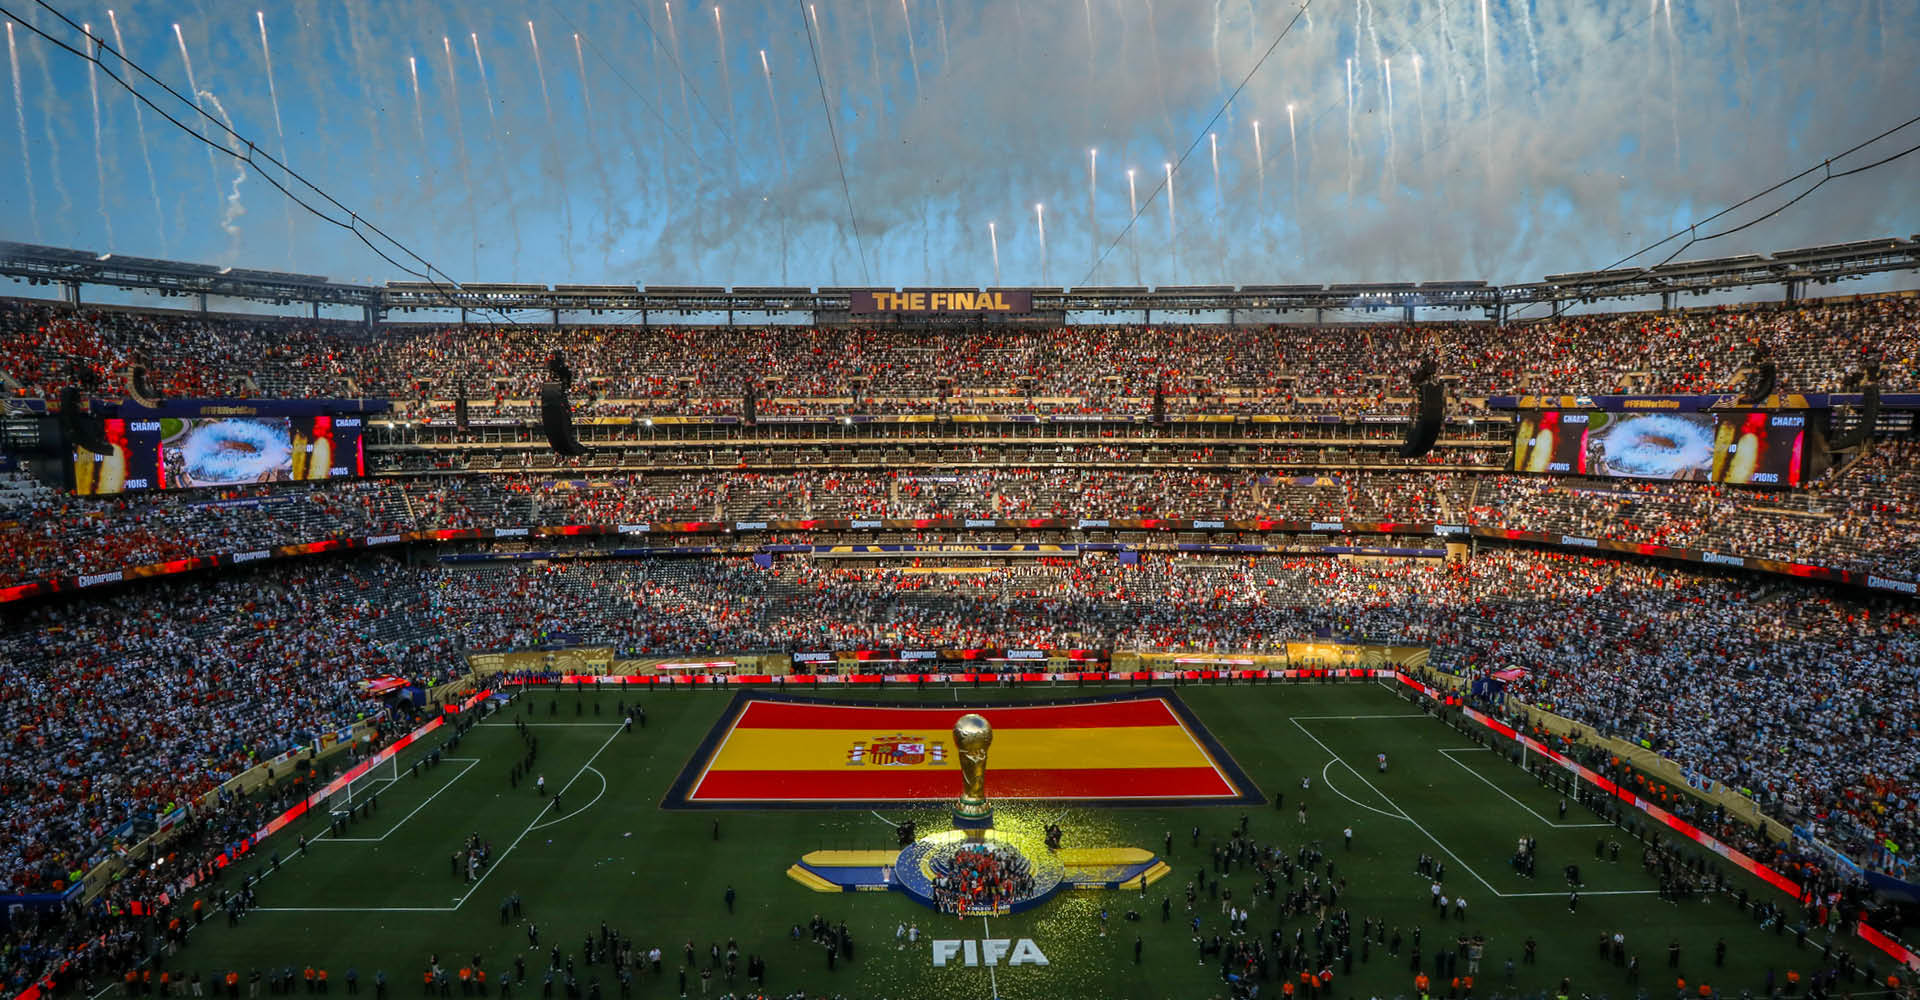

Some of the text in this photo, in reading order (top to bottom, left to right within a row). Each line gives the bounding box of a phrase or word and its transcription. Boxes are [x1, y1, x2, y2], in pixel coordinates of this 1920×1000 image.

[872, 292, 1010, 310] THE FINAL
[1624, 400, 1680, 408] #FIFAWorldCup
[233, 550, 270, 563] CHAMPIONS
[1703, 552, 1744, 567] CHAMPIONS
[79, 571, 122, 588] CHAMPIONS
[1868, 576, 1917, 593] CHAMPIONS
[794, 653, 829, 662] CHAMPIONS
[901, 651, 936, 660] CHAMPIONS
[1008, 650, 1043, 659] CHAMPIONS
[933, 939, 1049, 966] FIFA
